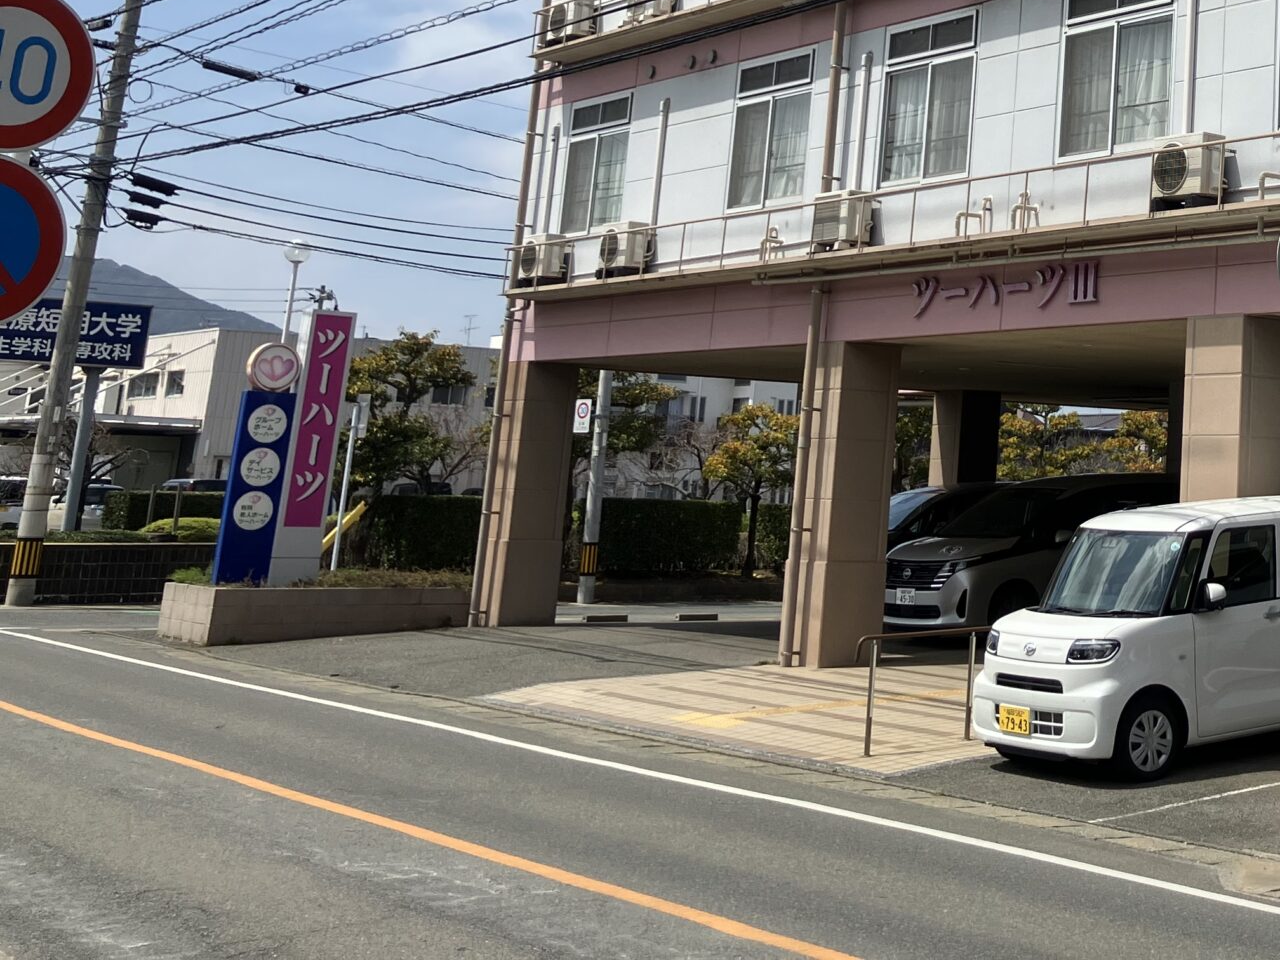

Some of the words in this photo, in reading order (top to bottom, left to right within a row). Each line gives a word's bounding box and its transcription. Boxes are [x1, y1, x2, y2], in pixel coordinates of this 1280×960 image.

[0, 28, 57, 105] 0
[295, 328, 346, 502] ツーハーツ
[247, 467, 274, 475] サービス
